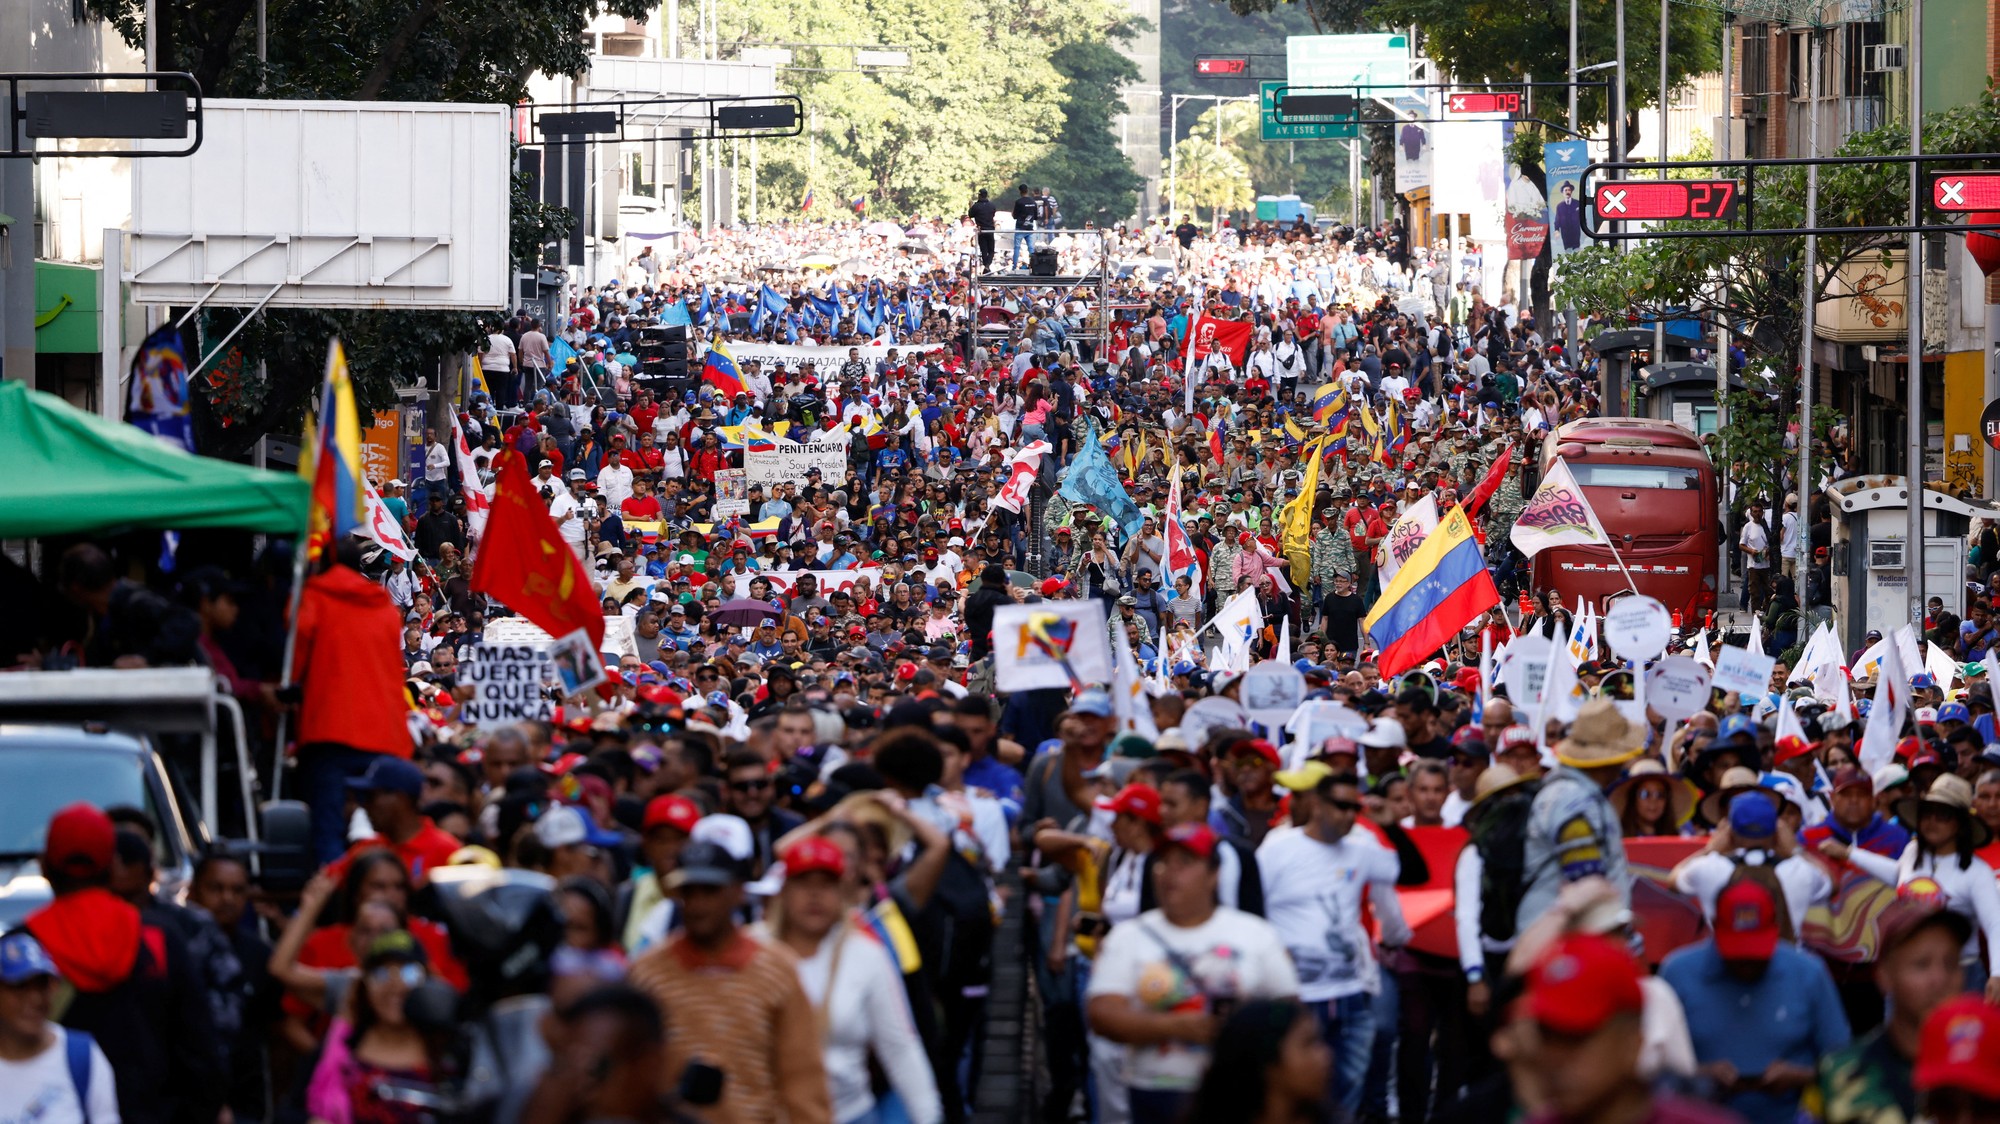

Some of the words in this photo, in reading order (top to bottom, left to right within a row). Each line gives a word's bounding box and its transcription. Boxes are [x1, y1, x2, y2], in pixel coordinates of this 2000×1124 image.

[1229, 60, 1245, 73] 27
[1496, 94, 1519, 113] 09
[1294, 126, 1315, 134] ESTE
[1690, 183, 1733, 218] 27
[1511, 223, 1544, 234] Carmen
[1987, 422, 1996, 436] EL
[779, 443, 843, 454] PENITENCIARIO
[765, 469, 776, 478] de
[780, 470, 805, 479] Venez
[477, 646, 533, 661] MAS
[459, 664, 553, 681] FUERTE
[485, 683, 538, 700] QUE
[466, 702, 551, 720] NUNCA
